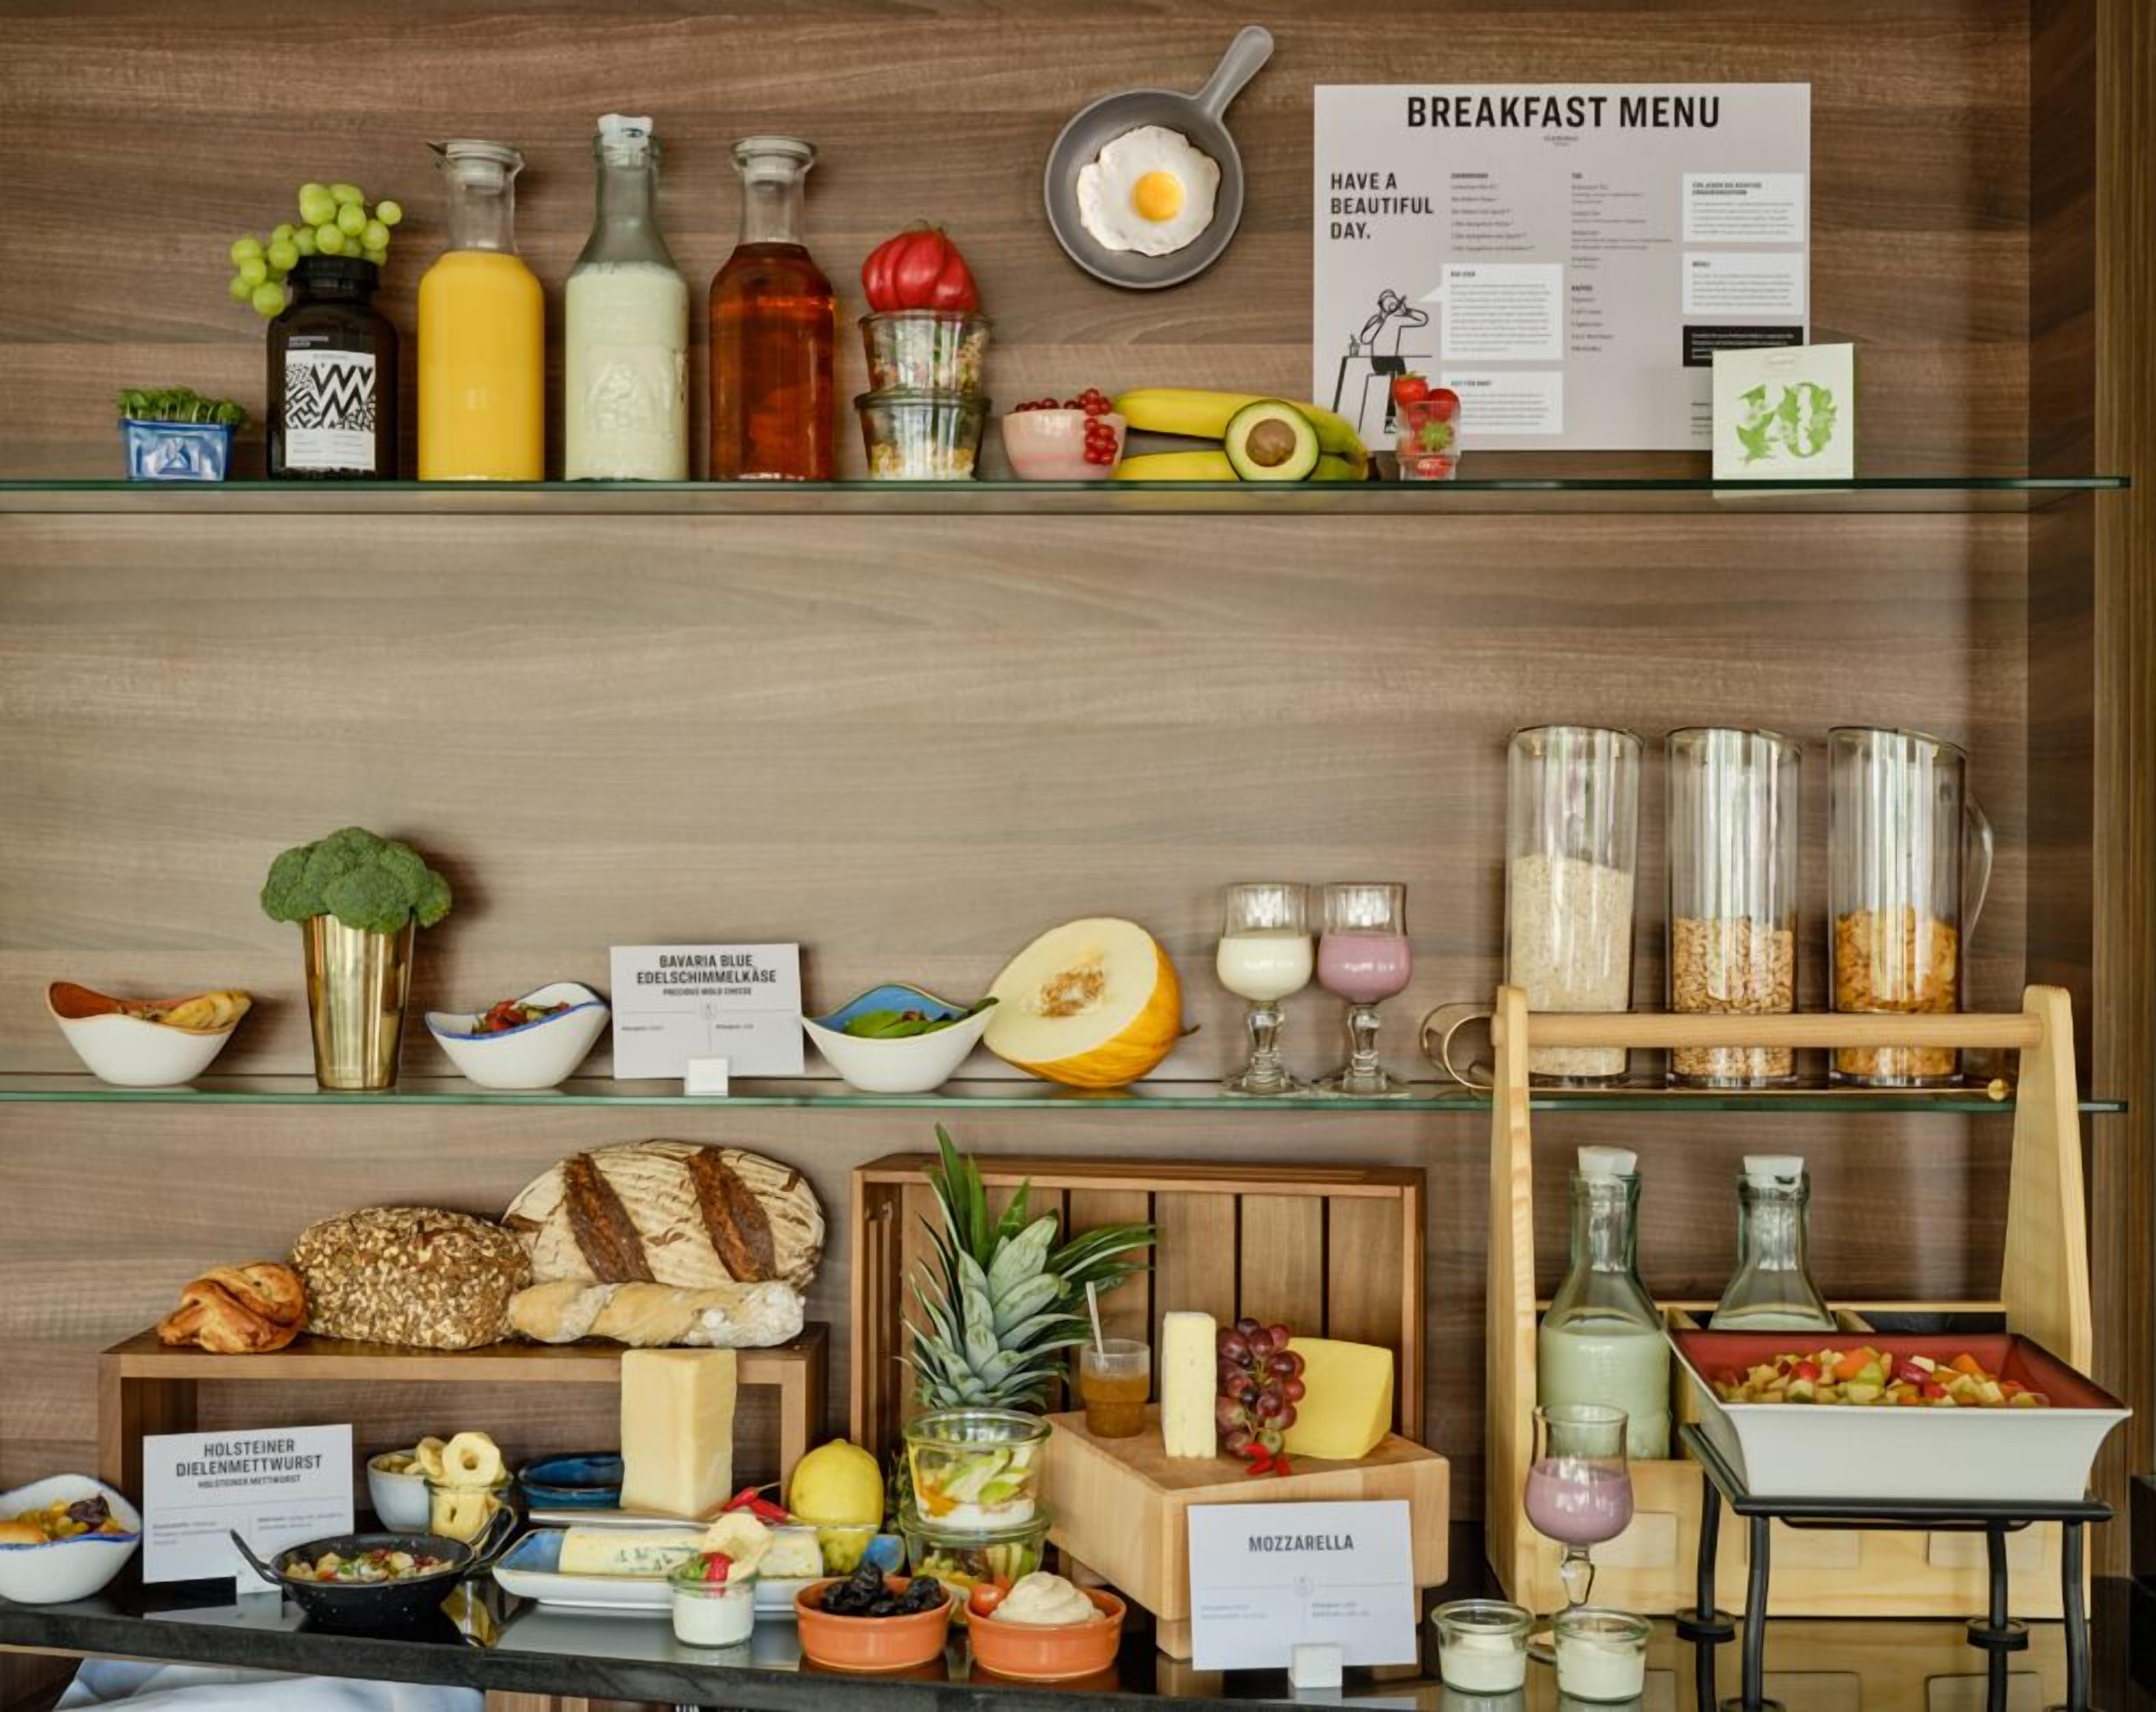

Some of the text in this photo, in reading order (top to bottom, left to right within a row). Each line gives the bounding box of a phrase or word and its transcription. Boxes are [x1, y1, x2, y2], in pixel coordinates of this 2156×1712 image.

[1407, 95, 1720, 128] BREAKFAST MENU
[1331, 172, 1398, 190] HAVE A
[1330, 196, 1434, 215] BEAUTIFUL
[1330, 221, 1371, 239] DAY.
[659, 954, 754, 968] BAVARIA BLUE
[204, 1438, 295, 1458] HOLSTEINER
[176, 1454, 322, 1478] DIELENMETTWURST
[1248, 1534, 1355, 1552] MOZZARELLA
